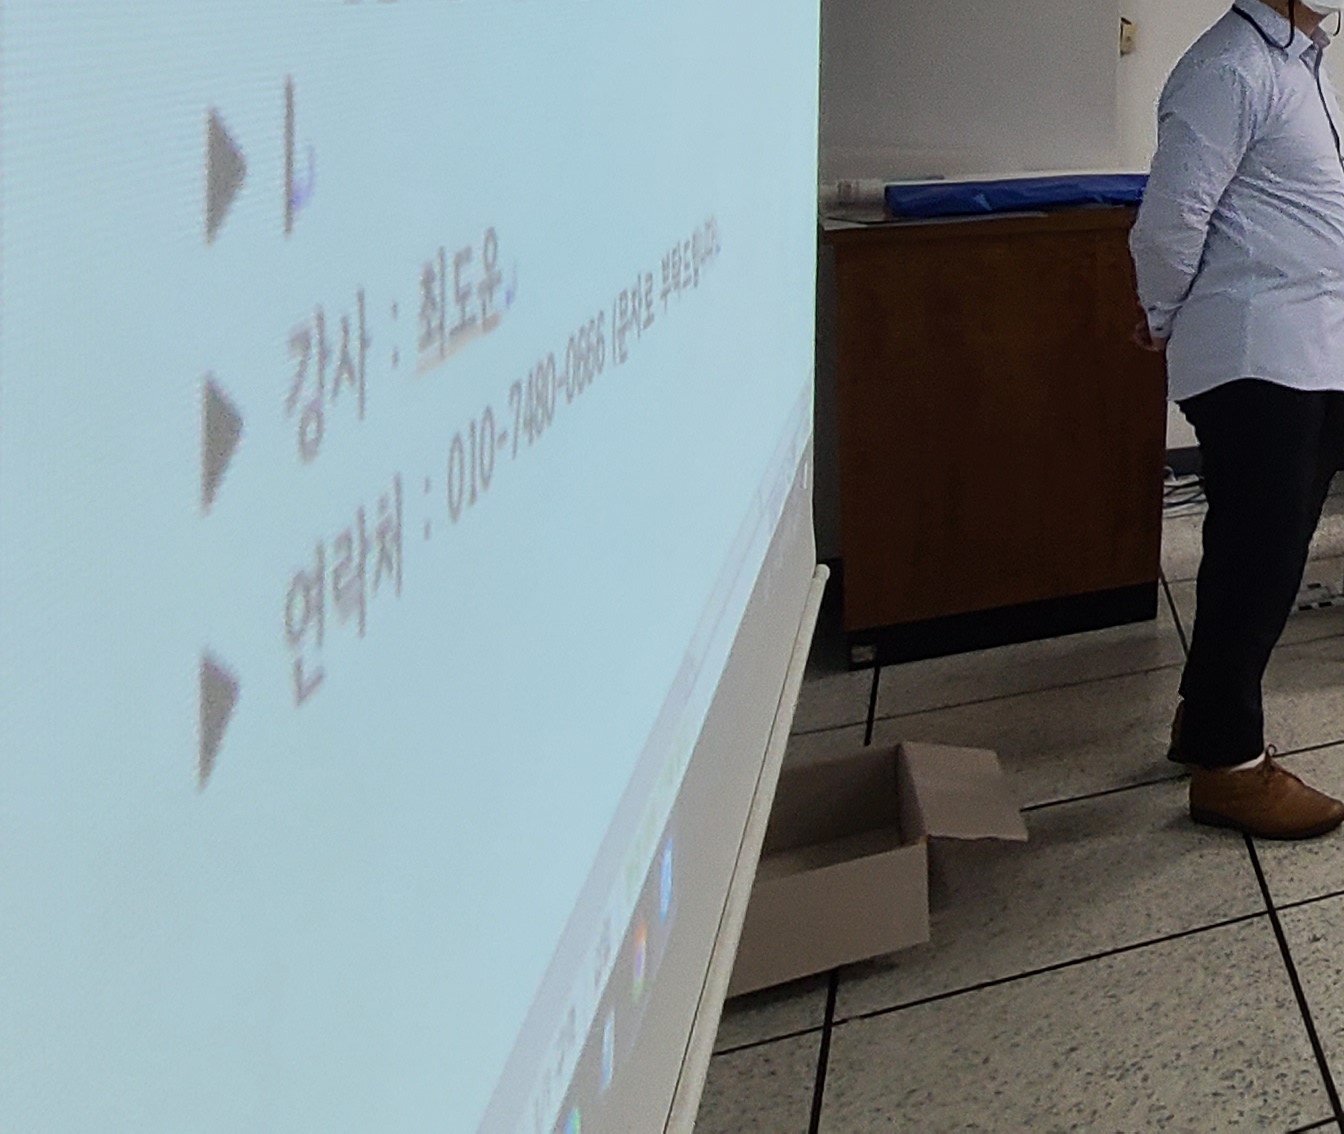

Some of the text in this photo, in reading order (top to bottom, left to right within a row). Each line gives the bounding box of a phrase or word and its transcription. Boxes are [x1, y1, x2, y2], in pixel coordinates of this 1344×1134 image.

[284, 471, 404, 708] 연락처
[611, 270, 656, 366] (문자로
[285, 286, 373, 464] 강사
[419, 225, 505, 358] 최도운
